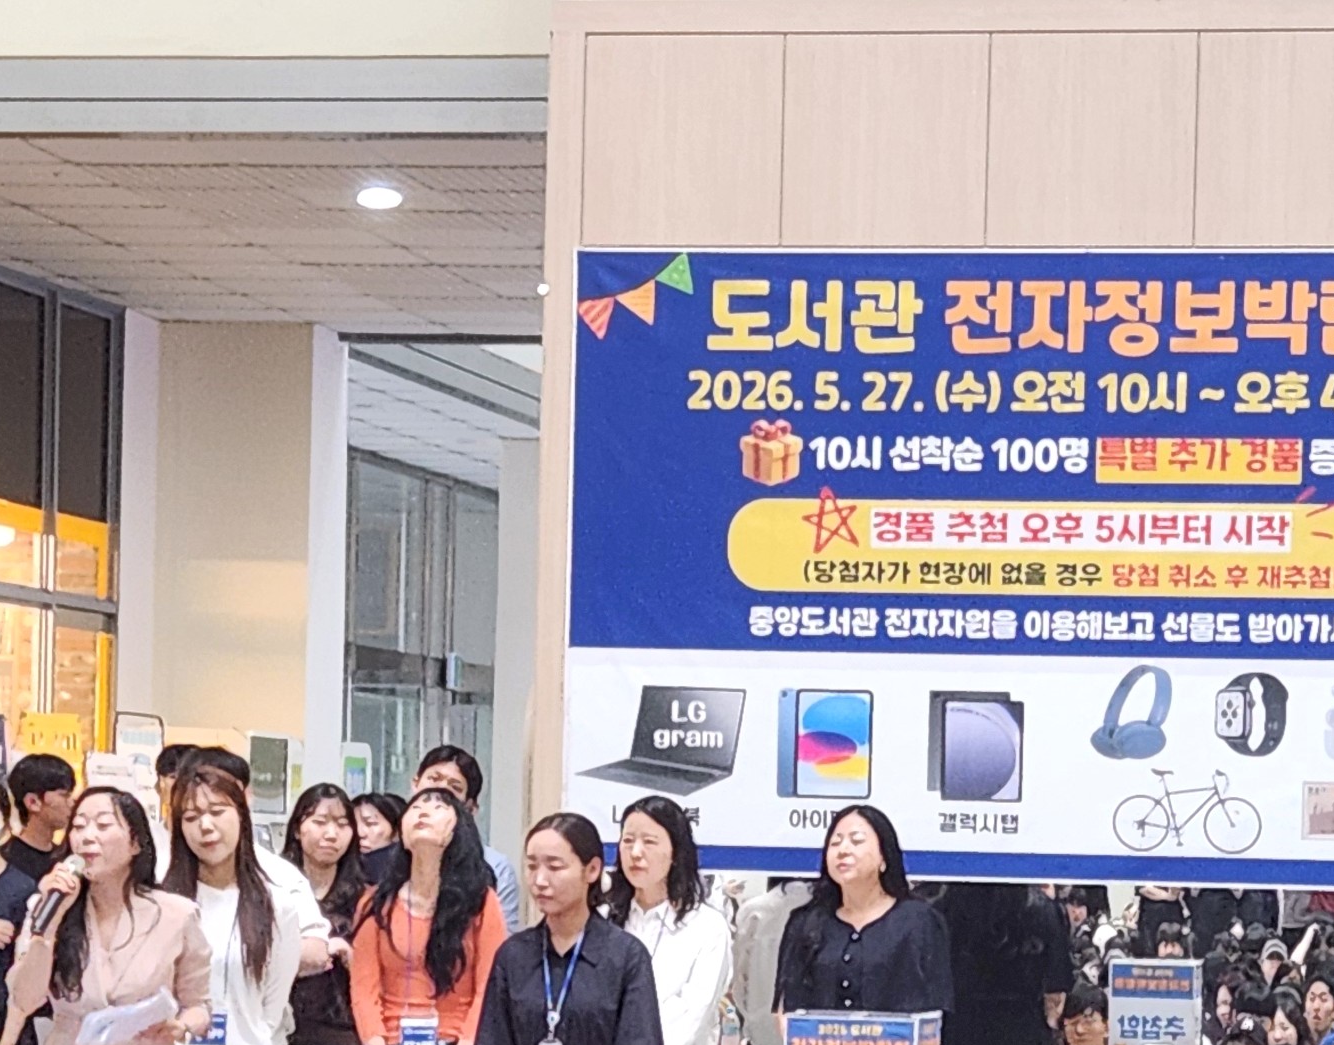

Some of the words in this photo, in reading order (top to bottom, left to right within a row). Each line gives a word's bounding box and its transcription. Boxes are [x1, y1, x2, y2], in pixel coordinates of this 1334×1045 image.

[706, 279, 924, 354] 도서관
[687, 369, 804, 411] 2026.
[814, 370, 851, 412] 5.
[861, 371, 925, 412] 27.
[934, 369, 1002, 413] (수)
[1010, 370, 1086, 413] 오전
[1097, 371, 1188, 413] 10시
[1198, 387, 1226, 402] ~
[1233, 371, 1311, 414] 오후
[808, 435, 882, 471] 10시
[888, 435, 984, 472] 선착순
[991, 436, 1089, 474] 100명
[1098, 438, 1158, 472] 특별
[1168, 438, 1231, 472] 추가
[1241, 438, 1303, 473] 경품
[873, 511, 935, 543] 경품
[945, 511, 1008, 543] 추첨
[1019, 512, 1084, 544] 오후
[1095, 513, 1212, 546] 5시부터
[1223, 514, 1290, 547] 시작
[803, 559, 911, 585] (당첨자가
[918, 561, 992, 585] 현장에
[1000, 562, 1047, 587] 없을
[1056, 562, 1103, 587] 경우
[1112, 563, 1160, 588] 당첨
[1168, 564, 1217, 589] 취소
[1224, 565, 1249, 589] 후
[748, 605, 880, 638] 중앙도서관
[884, 608, 1018, 640] 전자자원을
[1023, 609, 1156, 641] 이용해보고
[1161, 611, 1242, 643] 선물도
[670, 699, 707, 723] LG
[652, 727, 724, 750] gram
[938, 812, 1020, 835] 갤럭시탭
